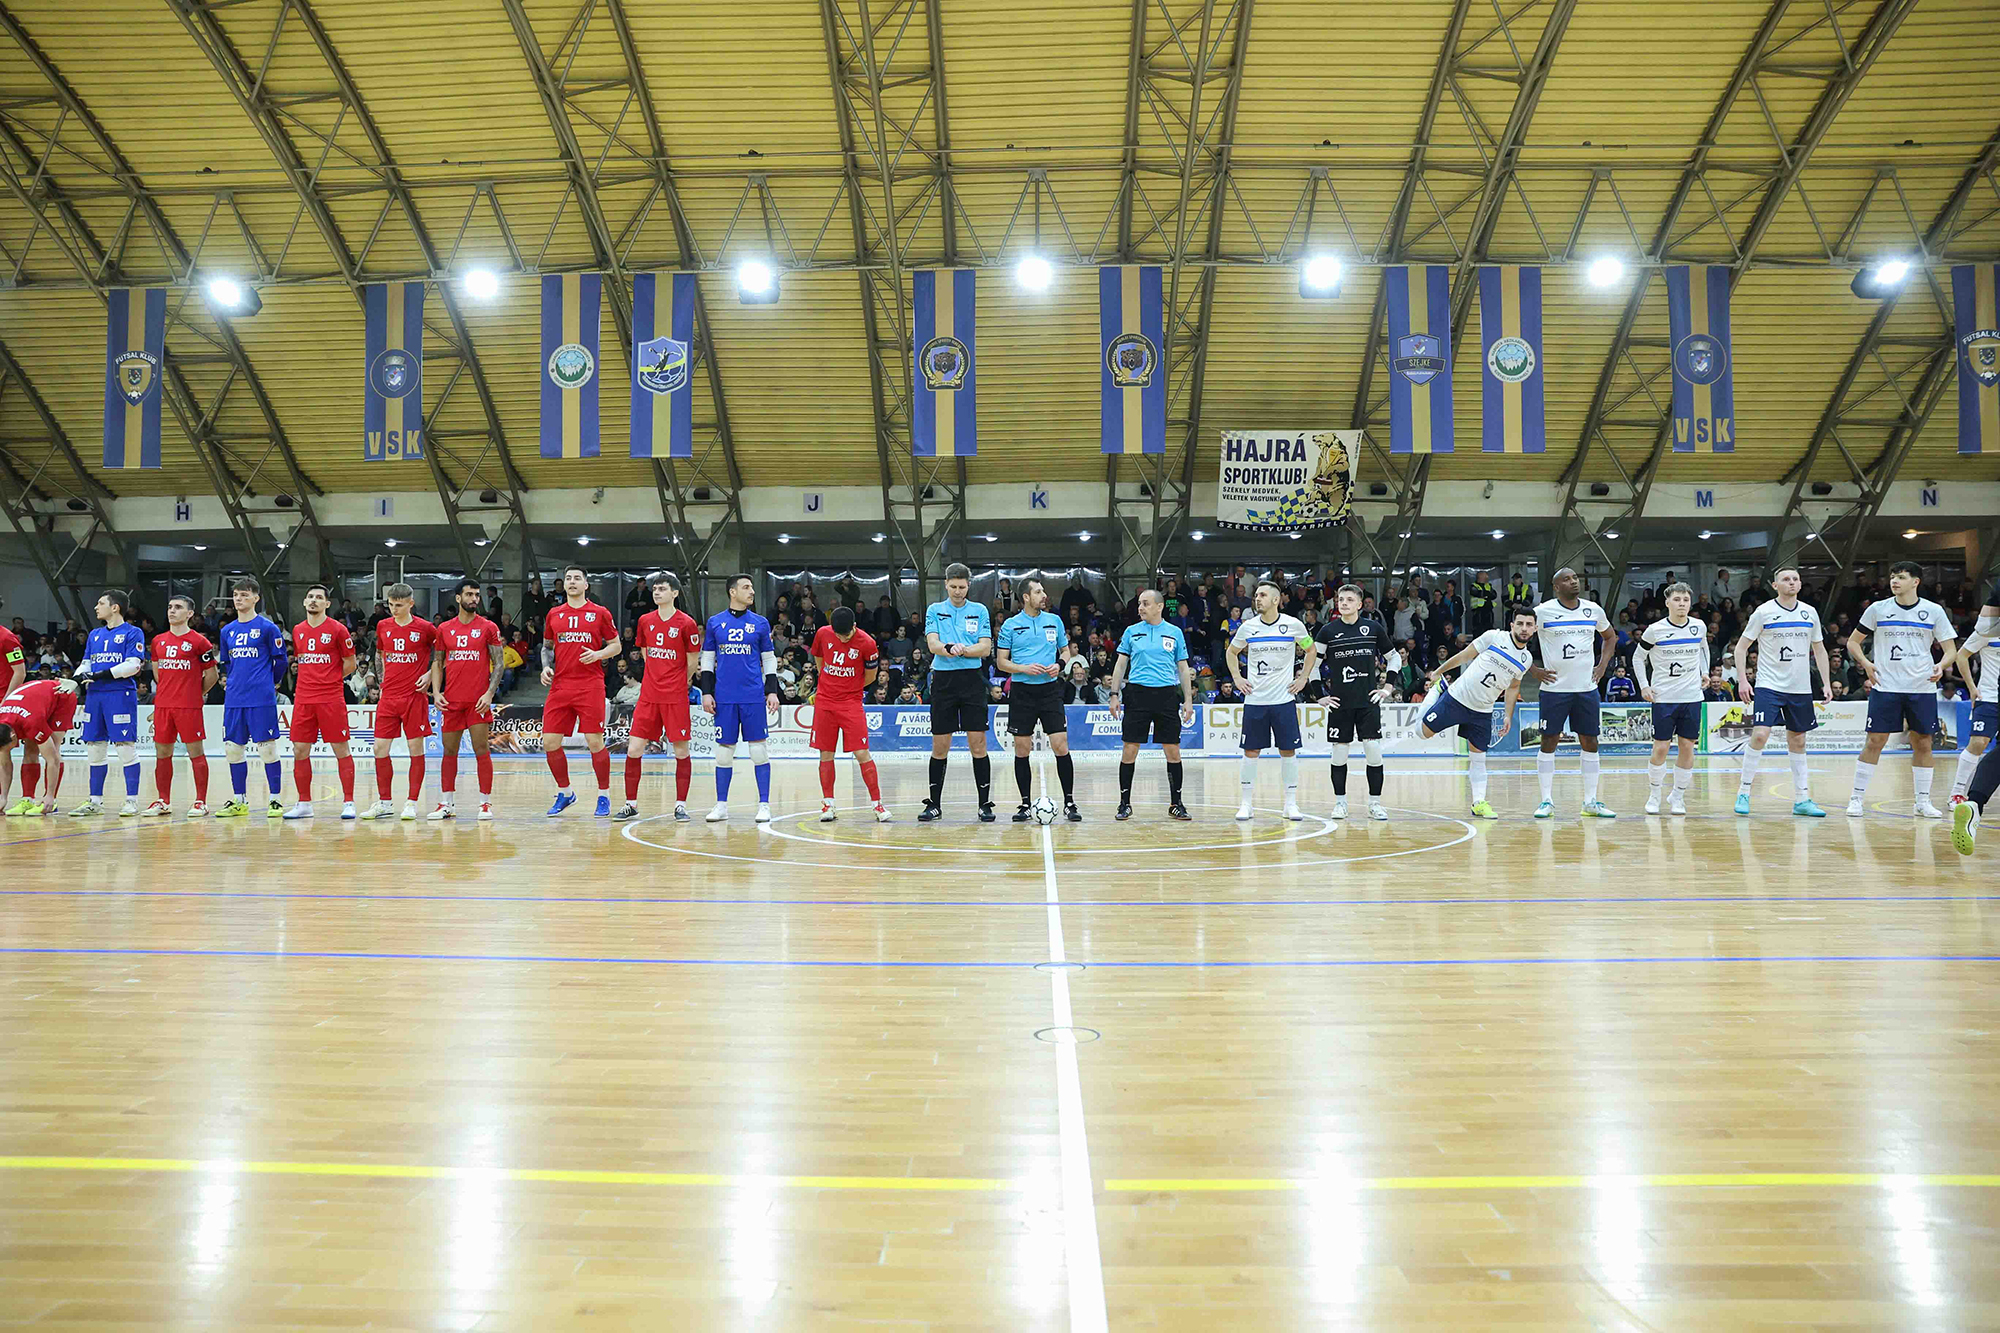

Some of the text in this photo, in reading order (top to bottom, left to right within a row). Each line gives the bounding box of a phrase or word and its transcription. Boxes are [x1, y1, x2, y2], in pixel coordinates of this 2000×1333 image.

[1962, 331, 1990, 344] FUTSAL
[115, 352, 157, 364] FUTSAL KLUB
[1409, 358, 1431, 367] SZEJKE
[1675, 418, 1732, 443] VSK
[368, 430, 421, 456] VSK
[1226, 432, 1307, 462] HAJRÁ
[1224, 467, 1308, 486] SPORTKLUB!
[1222, 486, 1250, 494] SZÉKELY
[808, 494, 819, 512] J
[1032, 492, 1046, 508] K
[1696, 491, 1713, 508] M
[1922, 489, 1936, 506] N
[177, 505, 189, 520] H
[1218, 520, 1346, 532] SZÉKELYUDVARHELY
[568, 616, 578, 628] 11
[235, 633, 248, 645] 21
[456, 635, 468, 647] 13
[656, 633, 664, 646] 9
[728, 629, 744, 642] 23
[103, 640, 109, 651] 1
[308, 638, 316, 651] 8
[392, 638, 405, 651] 18
[165, 646, 178, 657] 16
[202, 653, 210, 662] C
[832, 651, 845, 665] 14
[1091, 713, 1100, 721] ÎN
[1426, 712, 1438, 722] 8
[1755, 711, 1764, 722] 11
[1973, 721, 1985, 731] 13
[1329, 728, 1340, 739] 22
